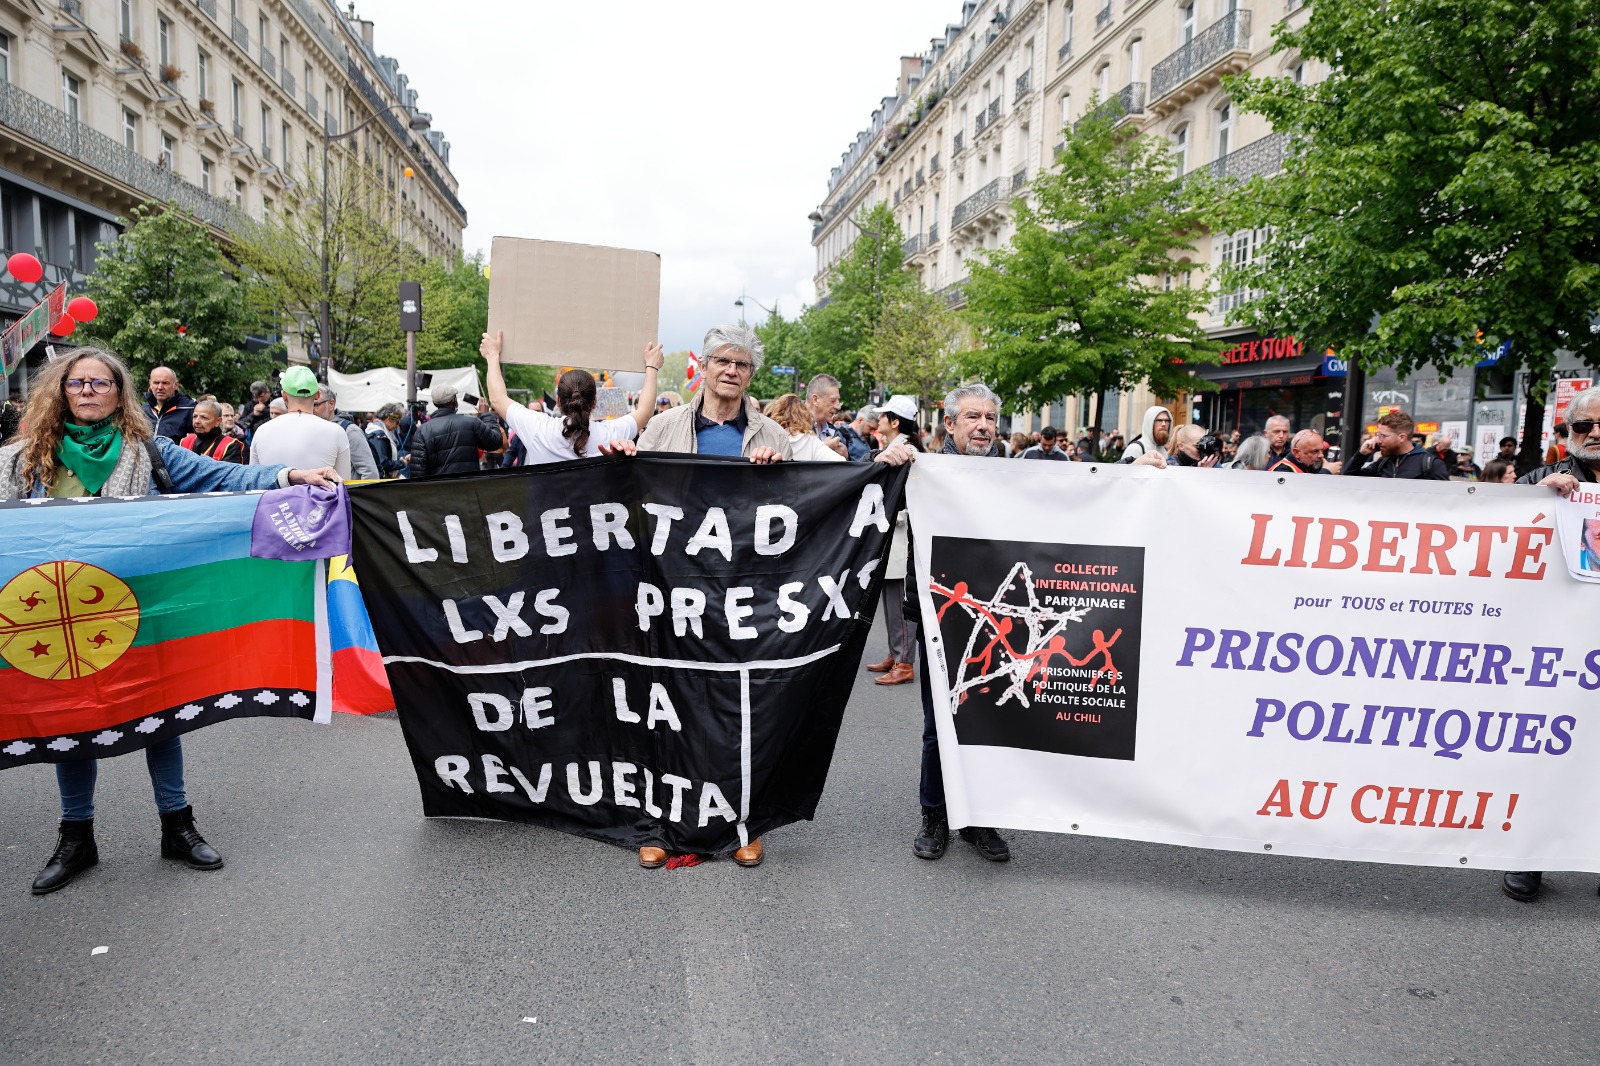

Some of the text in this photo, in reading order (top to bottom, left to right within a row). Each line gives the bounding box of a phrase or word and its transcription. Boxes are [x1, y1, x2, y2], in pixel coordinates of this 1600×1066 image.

[270, 512, 305, 551] LA CALLE
[279, 502, 310, 541] RAMIRO
[397, 484, 890, 562] LIBERTAD A
[1241, 513, 1554, 580] LIBERTÉ
[1035, 579, 1137, 594] INTERNATIONAL
[1054, 563, 1118, 576] COLLECTIF
[443, 589, 569, 643] LXS
[1044, 595, 1126, 609] PARRAINAGE
[1294, 595, 1502, 618] pour TOUS et TOUTES les
[1040, 667, 1123, 680] PRISONNIER-E-S
[1176, 627, 1600, 691] PRISONNIER-E-S
[468, 678, 681, 731] DE LA
[1032, 680, 1126, 694] POLITIQUES DE LA
[1034, 692, 1126, 708] RÉVOLTE SOCIALE
[1056, 711, 1101, 723] AU CHILI
[1247, 698, 1577, 760] POLITIQUES
[435, 755, 738, 827] REVUELTA
[1256, 779, 1337, 820] AU
